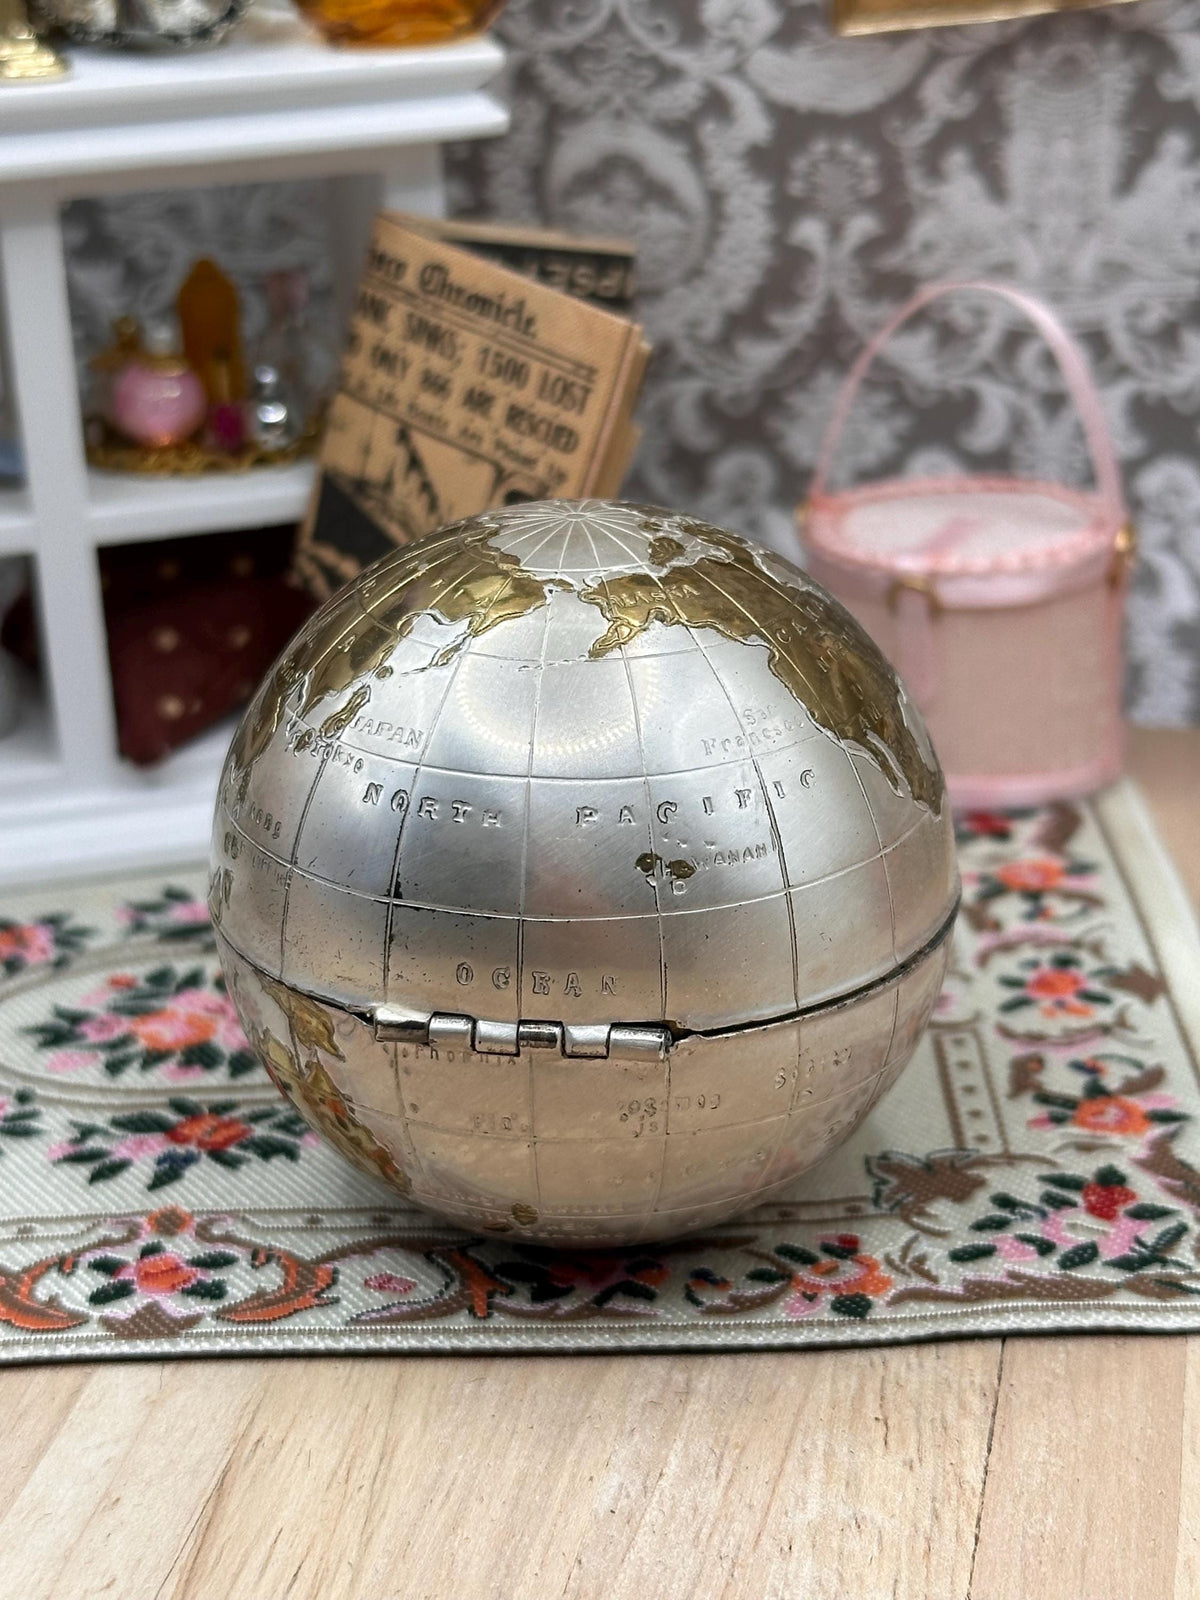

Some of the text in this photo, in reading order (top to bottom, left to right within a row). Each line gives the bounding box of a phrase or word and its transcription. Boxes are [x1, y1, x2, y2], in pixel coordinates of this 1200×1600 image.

[478, 345, 531, 389] 1500
[537, 367, 593, 417] LOST
[504, 402, 580, 456] RESCUED
[349, 714, 424, 750] JAPAN
[362, 767, 817, 829] NORTH PACIFIC
